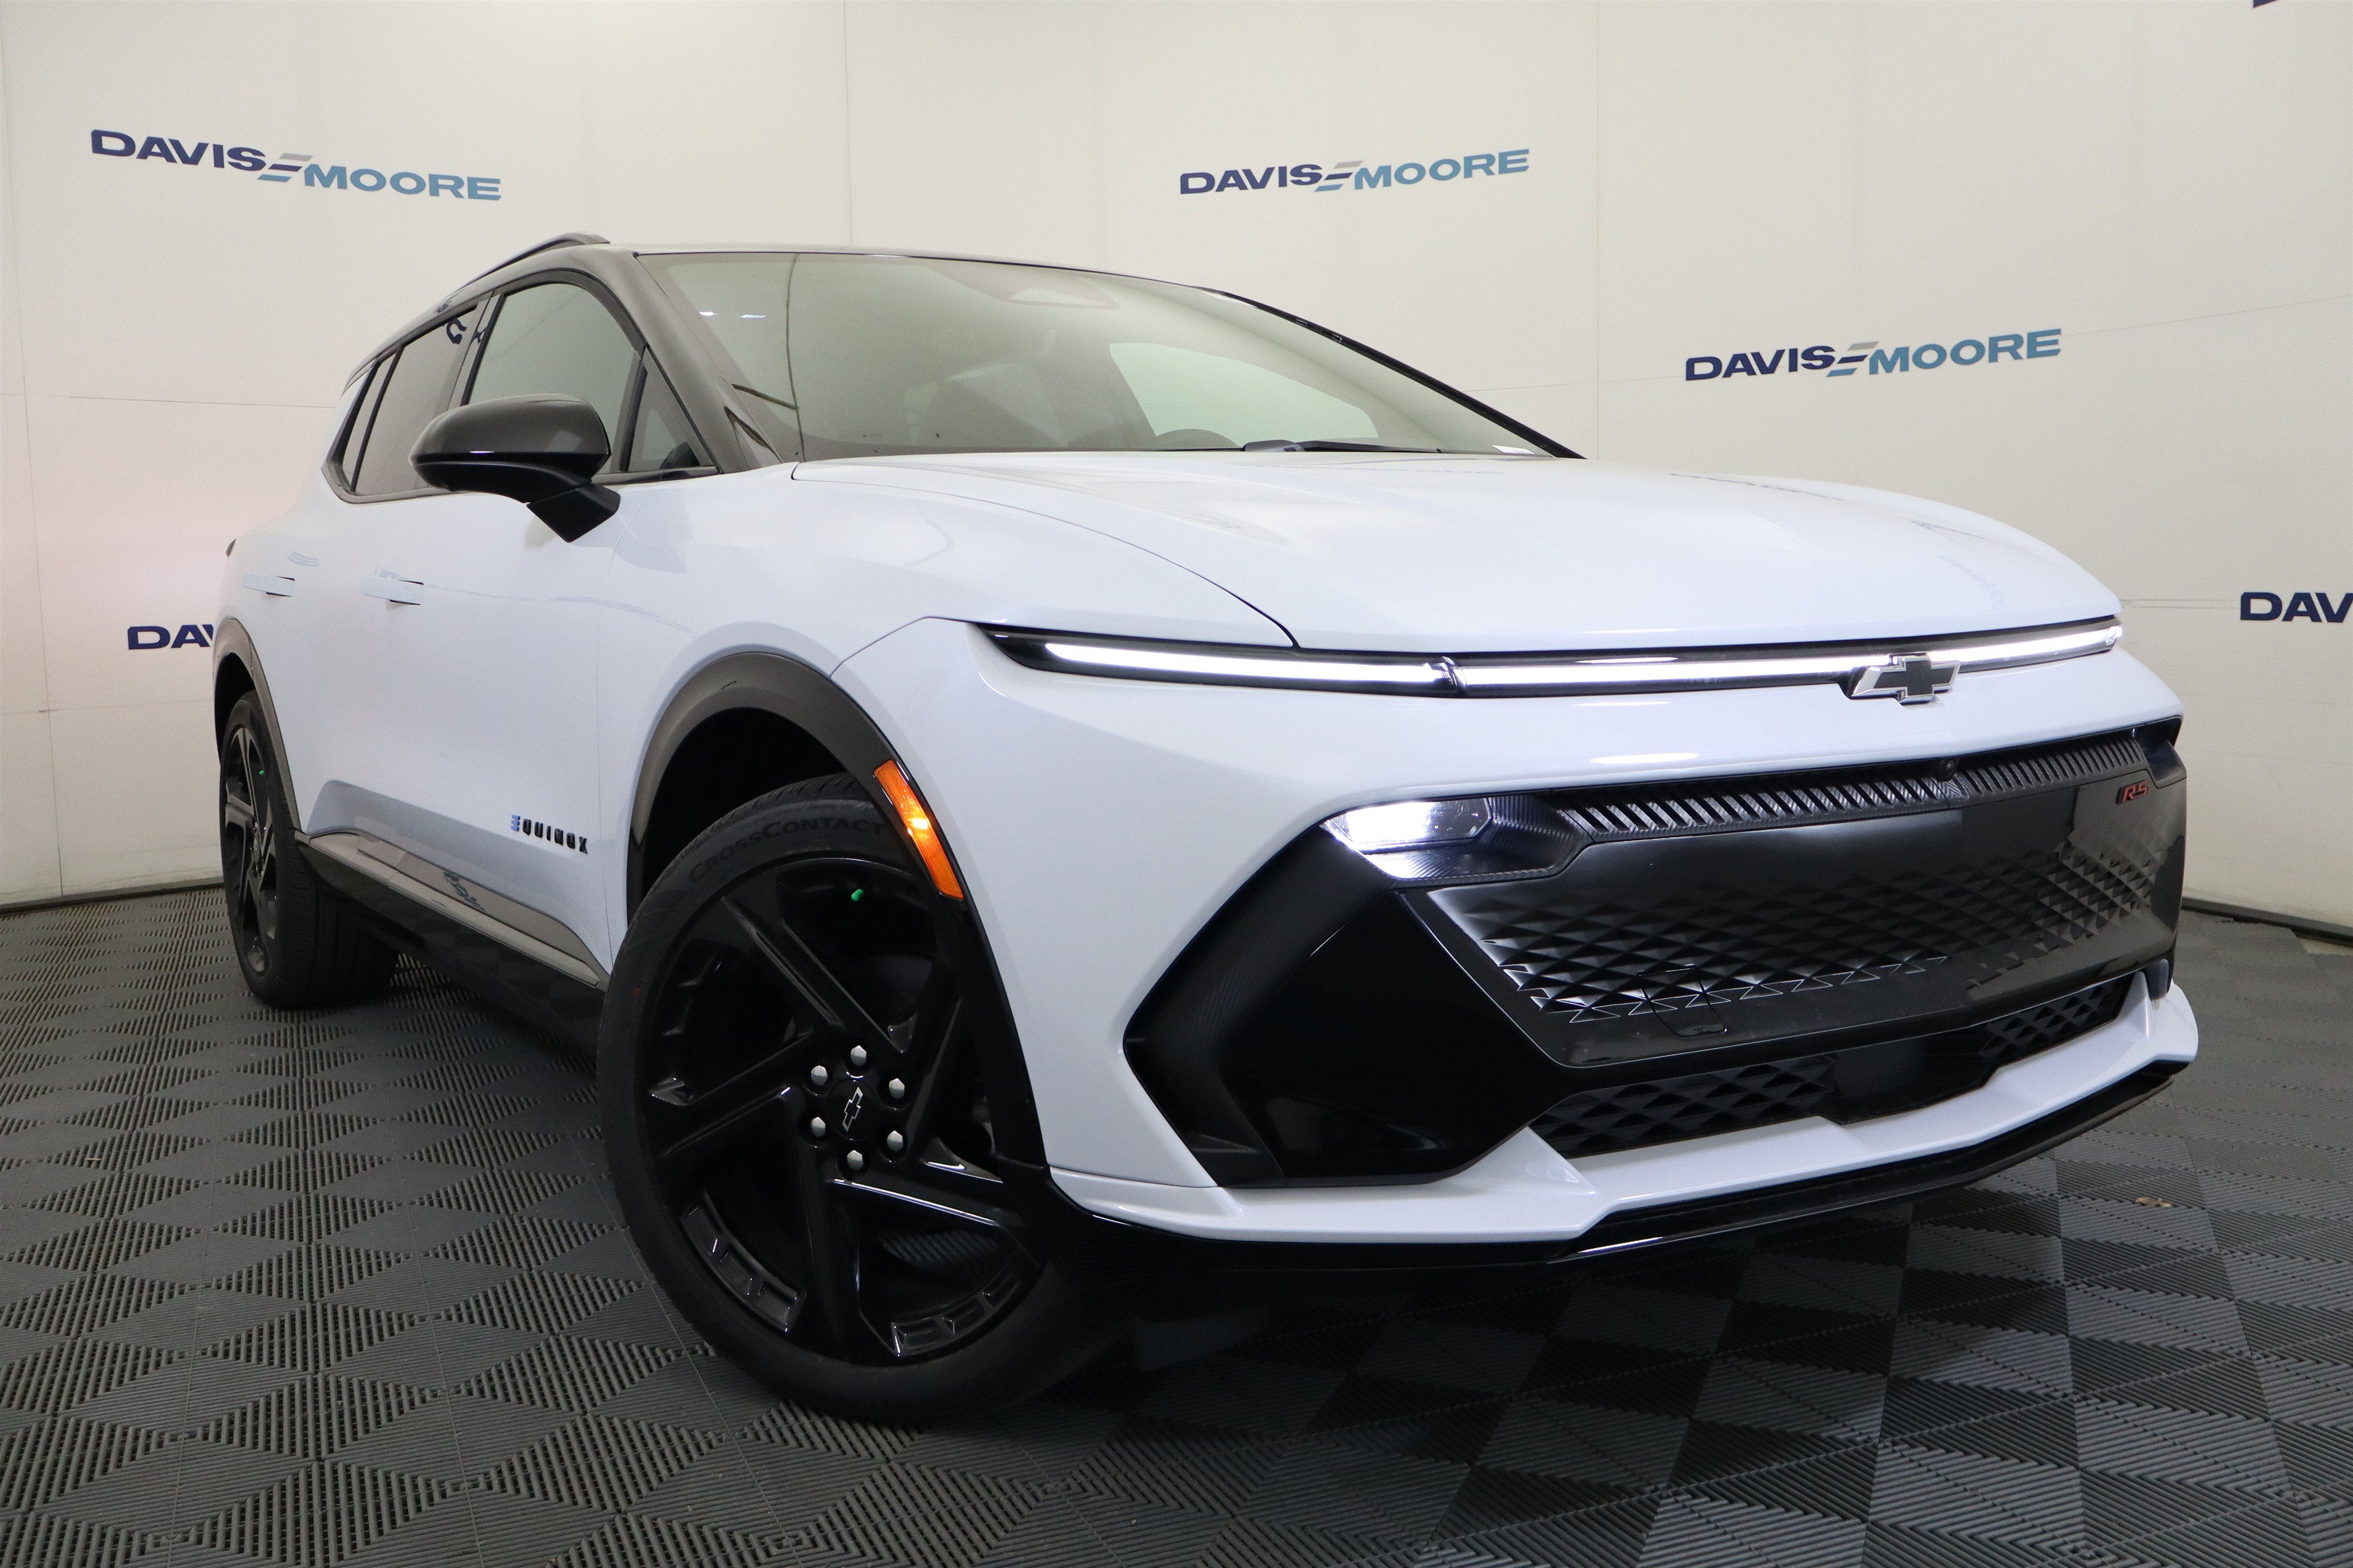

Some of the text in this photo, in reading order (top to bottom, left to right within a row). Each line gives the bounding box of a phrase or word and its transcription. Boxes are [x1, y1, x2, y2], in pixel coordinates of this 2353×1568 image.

[91, 129, 502, 200] DAVIS MOORE
[1180, 148, 1530, 194] DAVIS MOORE
[1685, 328, 2062, 381] DAVIS MOORE
[2118, 780, 2150, 804] RS
[511, 814, 588, 854] EQUINOX
